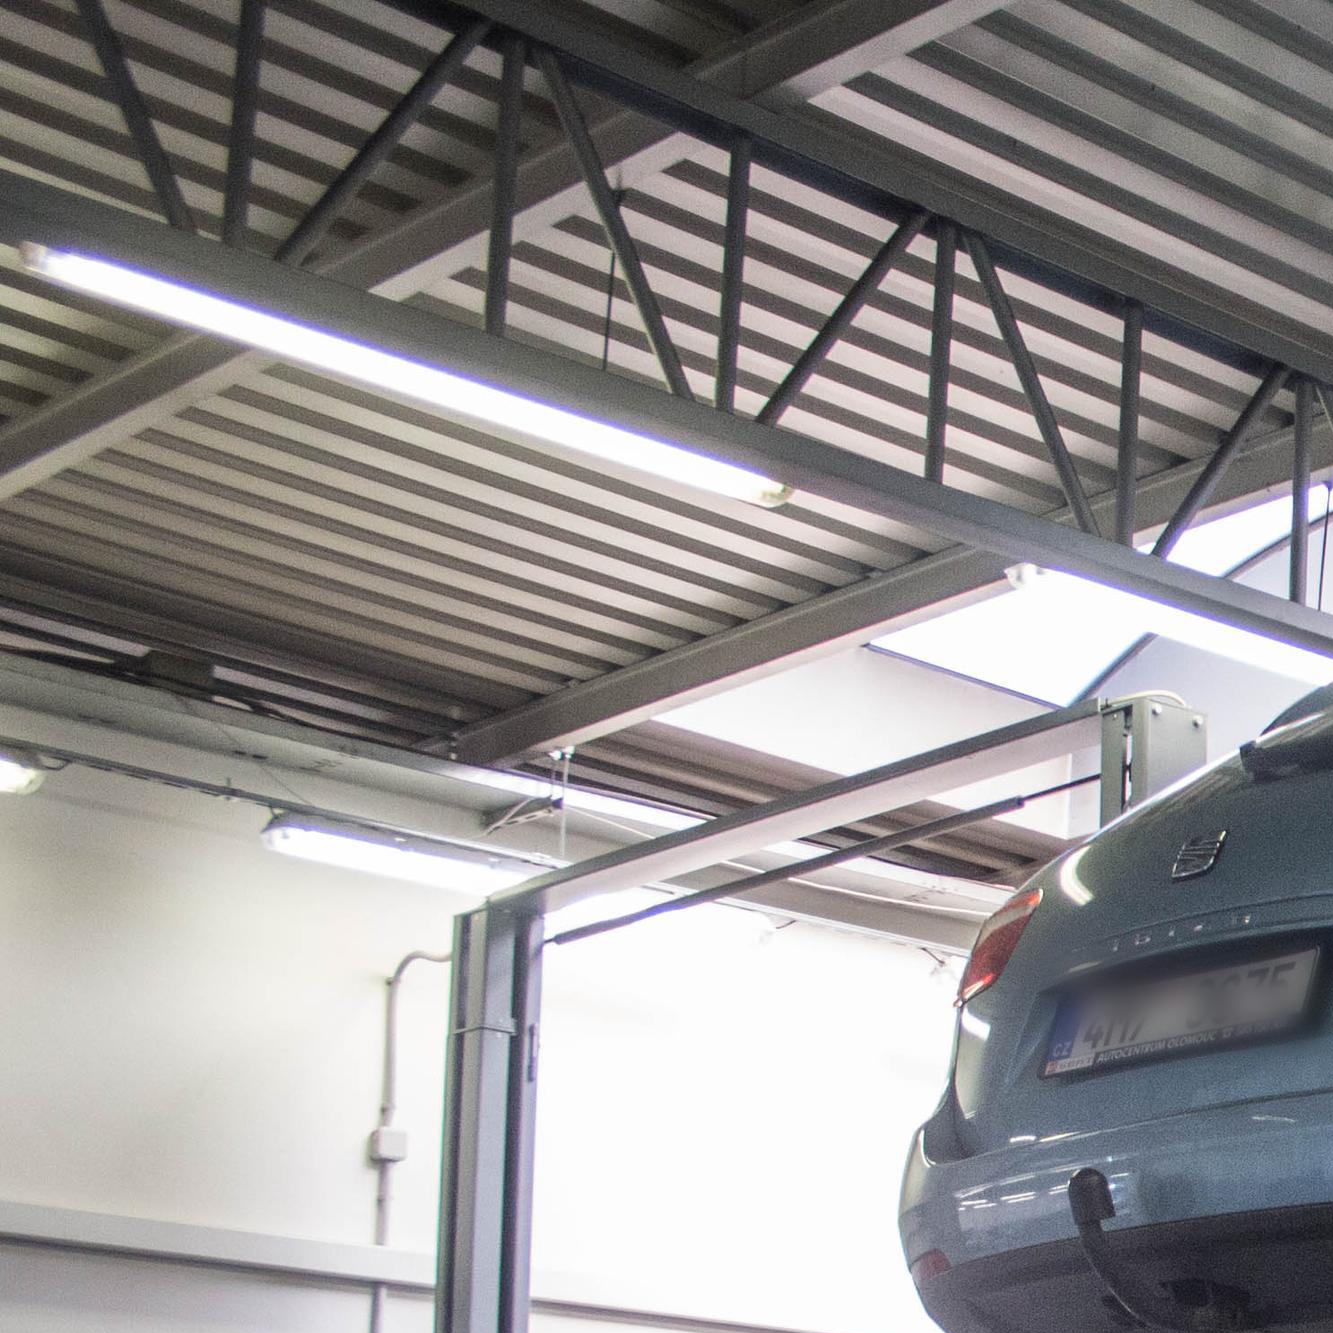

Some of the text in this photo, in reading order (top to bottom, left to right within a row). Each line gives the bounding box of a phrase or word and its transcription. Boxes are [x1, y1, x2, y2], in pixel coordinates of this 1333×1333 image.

[1052, 1041, 1073, 1057] CZ
[1097, 1030, 1217, 1064] AUTOCENTRUM OLOMOUC
